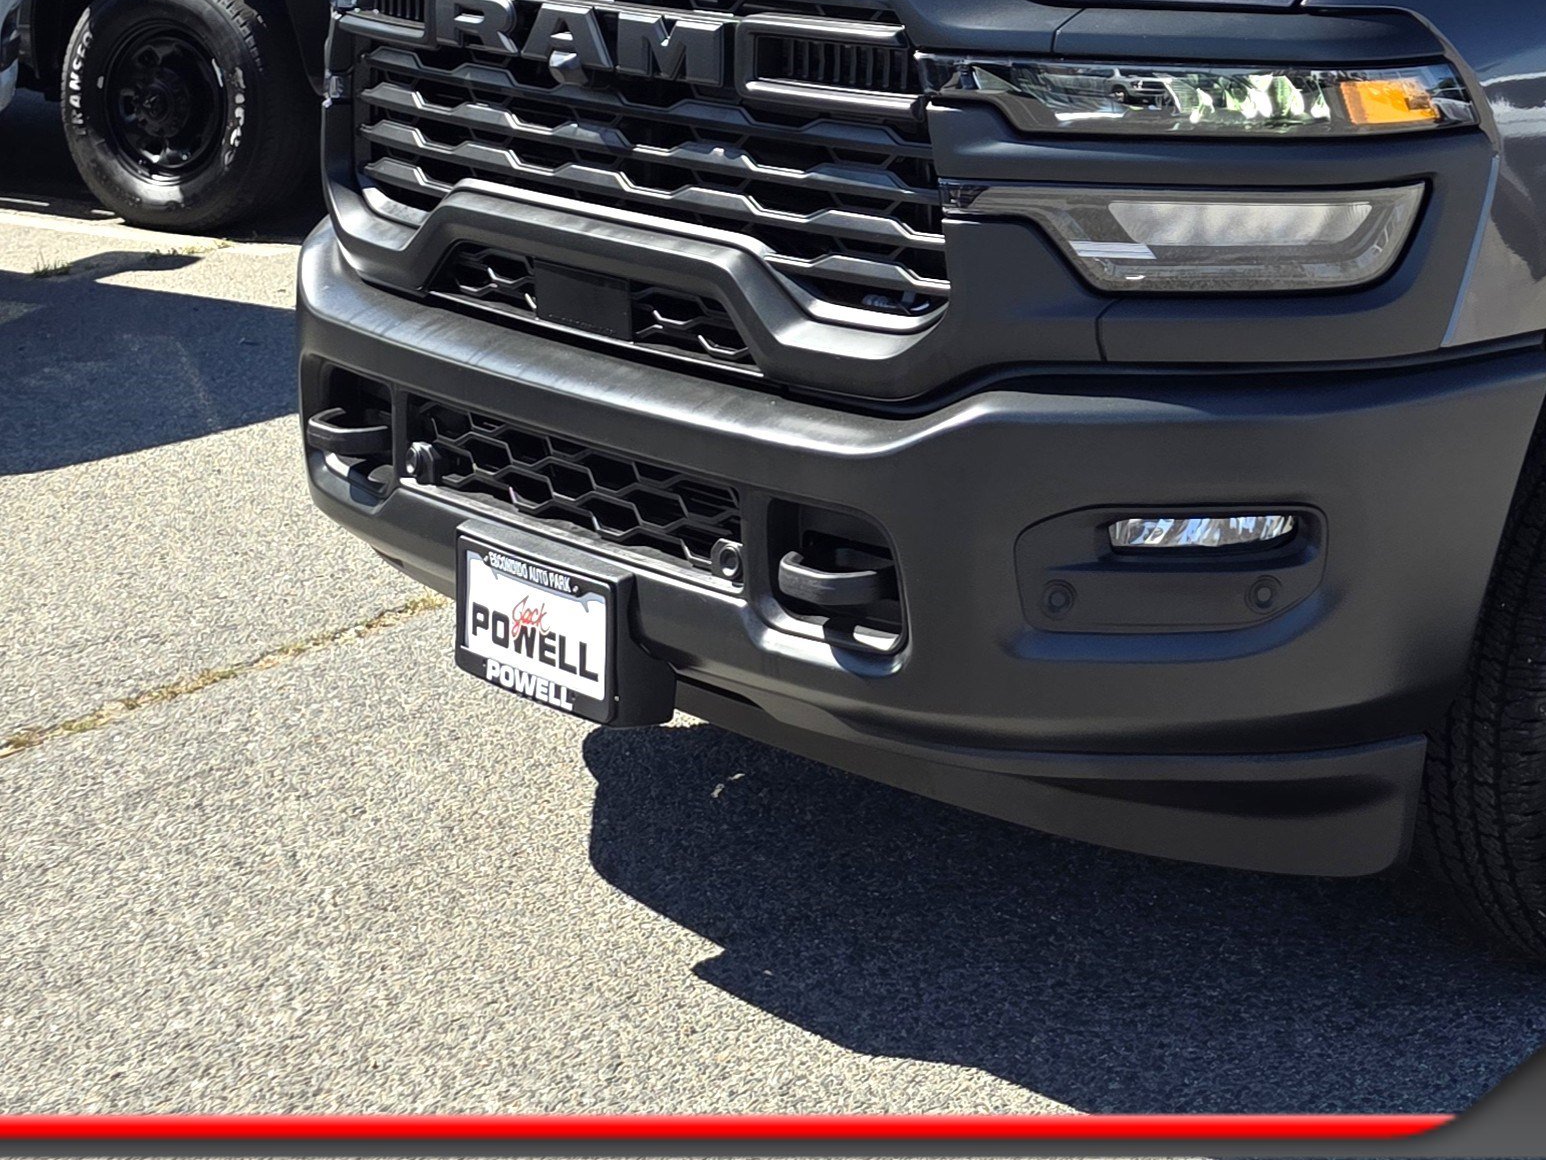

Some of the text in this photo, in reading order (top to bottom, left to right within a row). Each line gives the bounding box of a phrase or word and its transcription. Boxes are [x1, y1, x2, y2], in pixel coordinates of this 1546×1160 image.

[529, 566, 549, 586] AUTO
[549, 572, 572, 593] PARK
[471, 601, 599, 682] POWELL
[511, 595, 550, 640] Jack
[486, 658, 574, 712] POWELL
